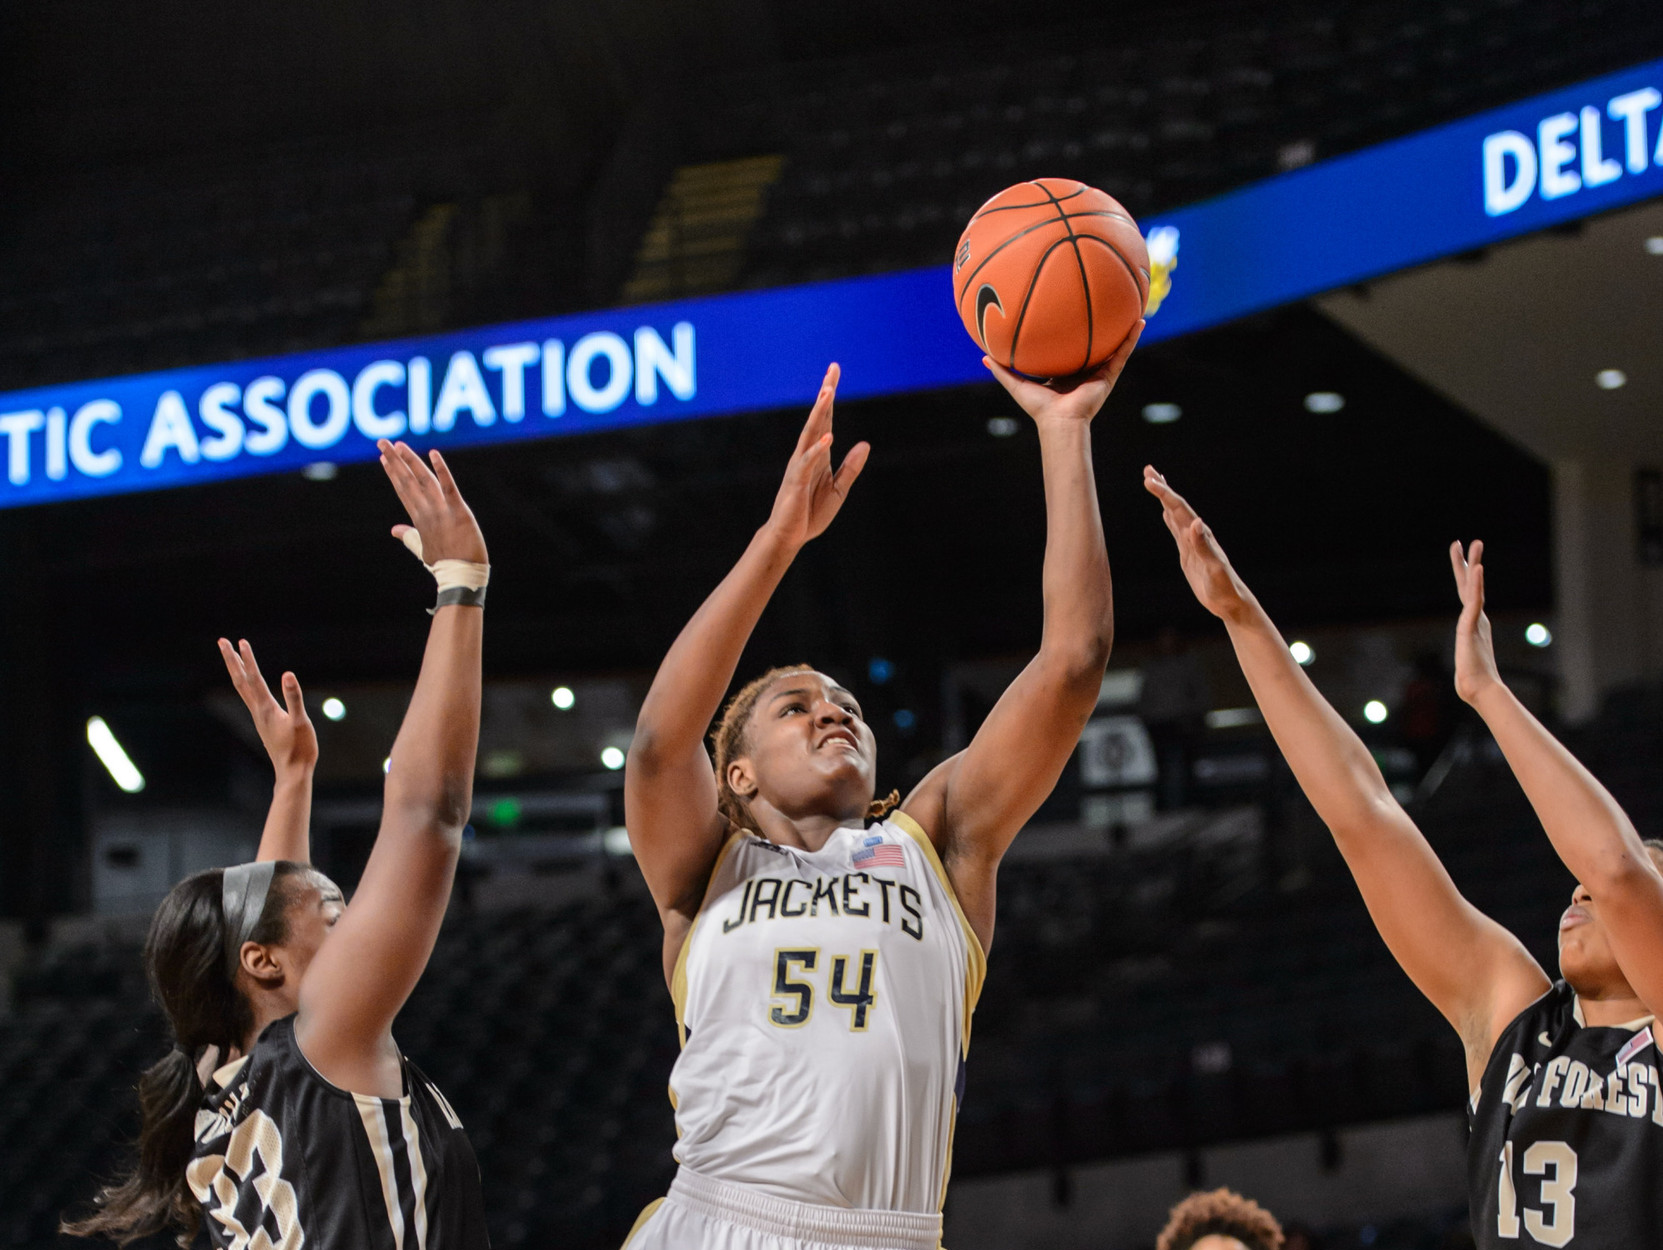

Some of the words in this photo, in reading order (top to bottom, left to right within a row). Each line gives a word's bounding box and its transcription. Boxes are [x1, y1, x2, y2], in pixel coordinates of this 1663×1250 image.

[1482, 86, 1663, 218] DELT
[0, 398, 123, 486] TIC
[139, 320, 697, 469] ASSOCIATION
[722, 871, 924, 942] JACKETS
[767, 947, 879, 1033] 54
[1497, 1140, 1578, 1249] 13
